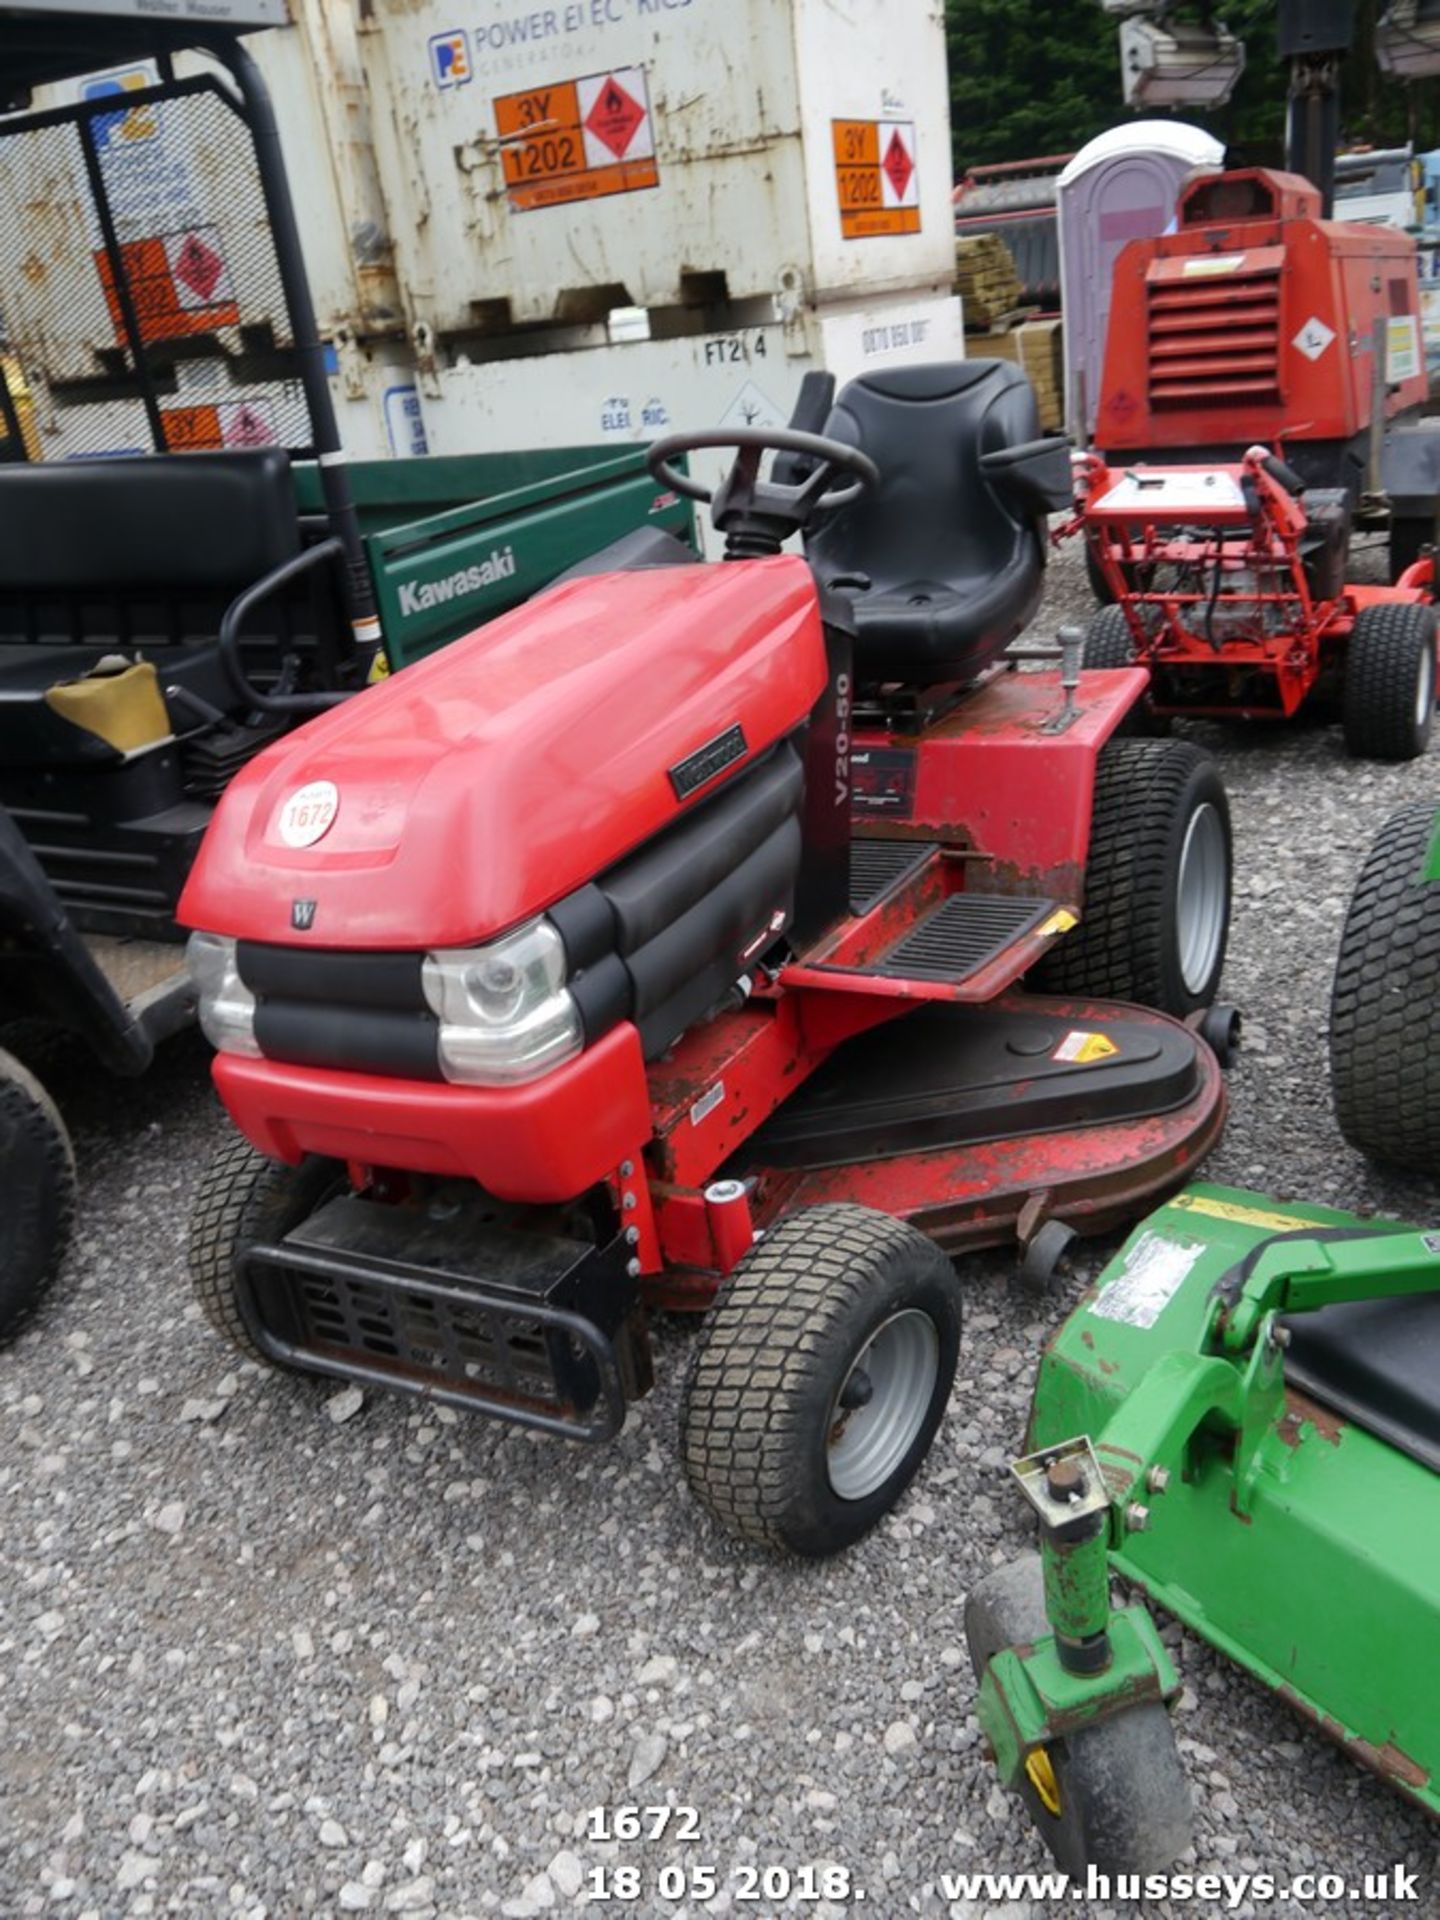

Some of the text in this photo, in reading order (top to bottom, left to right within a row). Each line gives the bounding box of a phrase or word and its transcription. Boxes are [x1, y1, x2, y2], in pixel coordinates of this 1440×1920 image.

[475, 10, 556, 51] POWER
[517, 92, 552, 129] 3Y
[511, 136, 577, 177] 1202
[845, 126, 866, 160] 3Y
[840, 172, 879, 203] 1202
[398, 546, 516, 617] Kawasaki
[835, 673, 849, 806] V20-50
[288, 802, 333, 828] 1672
[294, 902, 315, 925] W
